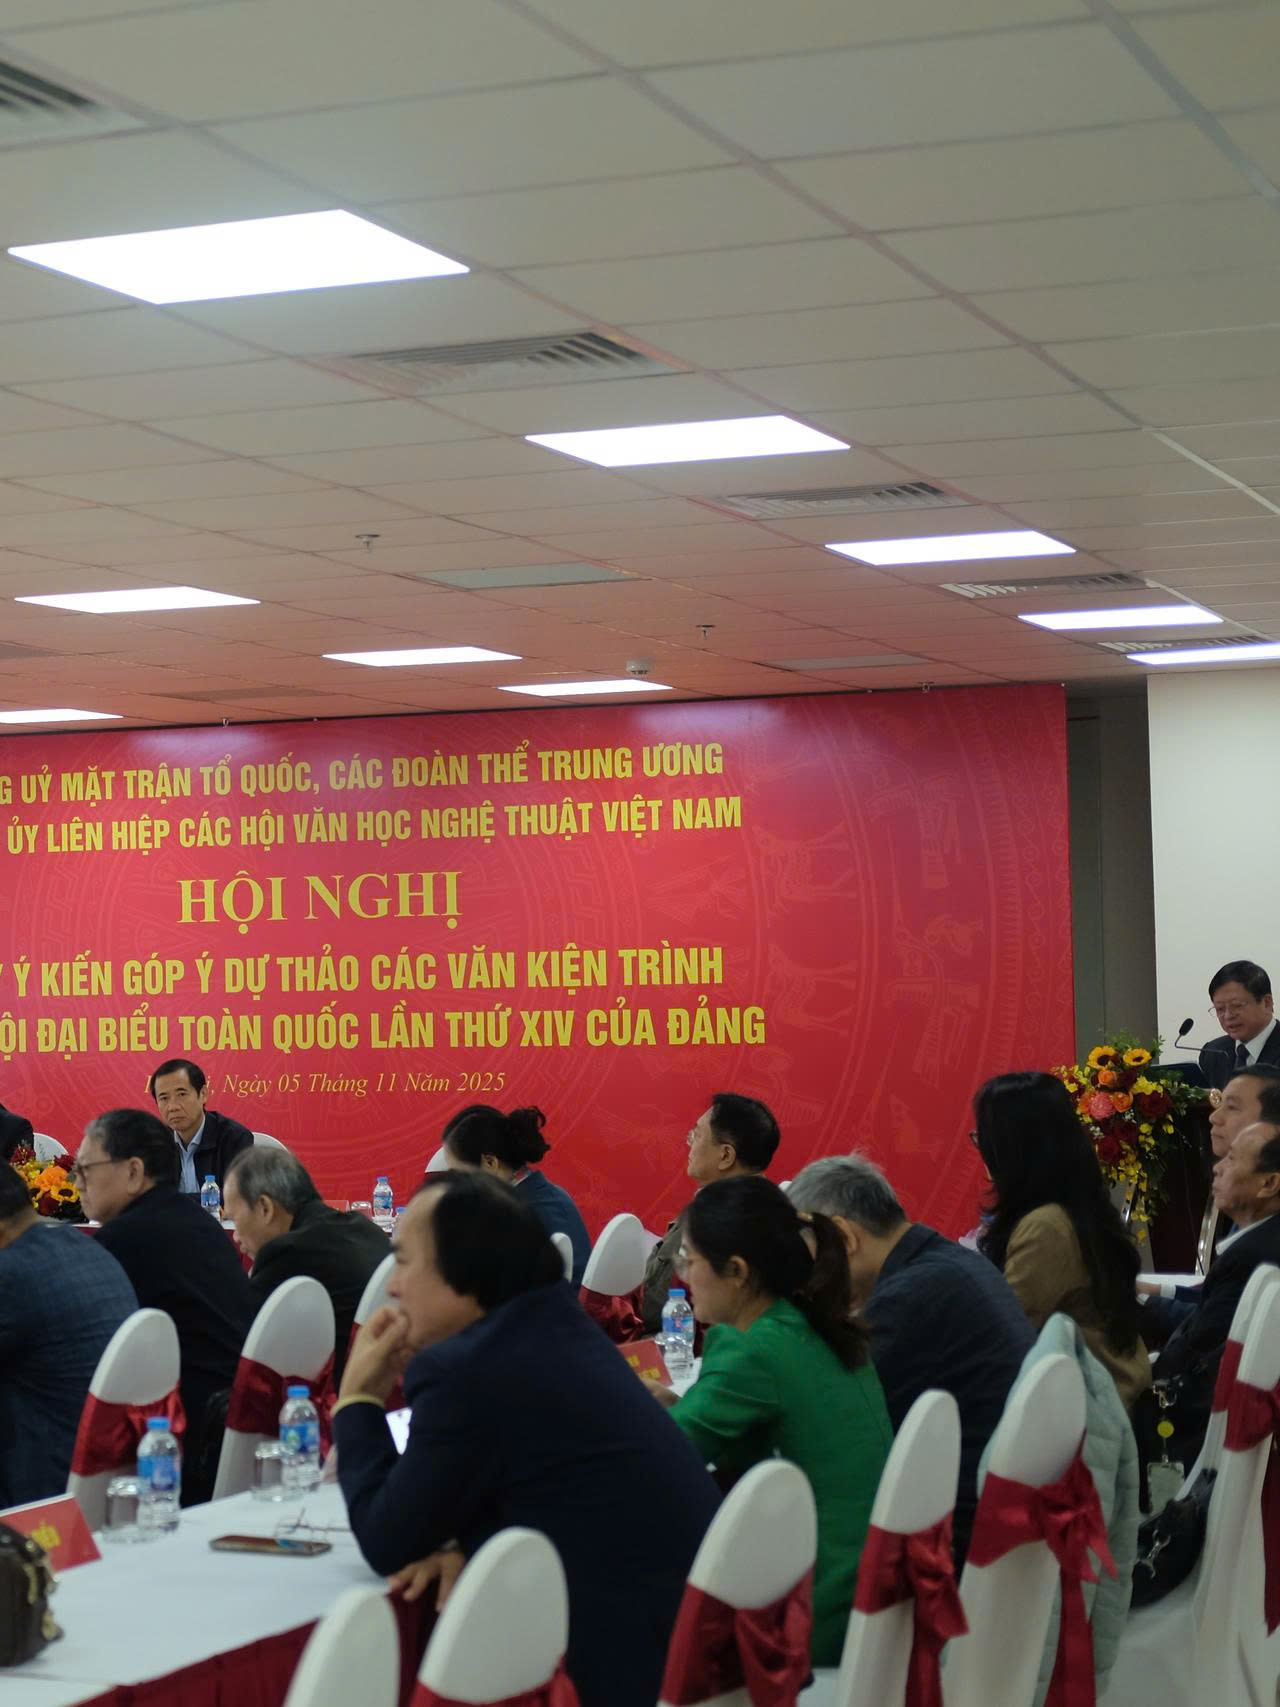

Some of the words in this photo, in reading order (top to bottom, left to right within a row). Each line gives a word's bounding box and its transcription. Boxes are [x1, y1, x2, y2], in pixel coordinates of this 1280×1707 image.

[21, 765, 52, 803] UỶ
[62, 766, 115, 807] MẶT
[124, 762, 191, 804] TRẬN
[200, 754, 231, 795] TỔ
[240, 751, 320, 797] QUỐC,
[329, 754, 382, 790] CÁC
[392, 750, 468, 787] ĐOÀN
[478, 740, 529, 784] THỂ
[538, 747, 632, 781] TRUNG
[643, 742, 722, 777] ƯƠNG
[8, 816, 38, 854] ỦY
[48, 817, 102, 852] LIÊN
[112, 814, 169, 855] HIỆP
[180, 811, 231, 847] CÁC
[241, 809, 284, 851] HỘI
[293, 807, 347, 843] VĂN
[357, 810, 411, 847] HỌC
[421, 800, 495, 843] NGHỆ
[504, 797, 593, 840] THUẬT
[602, 794, 662, 838] VIỆT
[673, 797, 741, 829] NAM
[177, 871, 287, 934] HỘI
[304, 872, 462, 929] NGHỊ
[13, 956, 30, 997] Ý
[42, 950, 112, 996] KIẾN
[123, 952, 184, 995] GÓP
[195, 951, 213, 993] Ý
[225, 954, 269, 1000] DỰ
[277, 944, 359, 992] THẢO
[372, 947, 436, 990] CÁC
[448, 945, 515, 988] VĂN
[528, 943, 607, 995] KIỆN
[618, 941, 722, 985] TRÌNH
[37, 1018, 87, 1060] ĐẠI
[99, 1002, 168, 1051] BIỂU
[179, 1008, 261, 1050] TOÀN
[273, 1001, 358, 1053] QUỐC
[371, 1000, 433, 1048] LẦN
[445, 1003, 512, 1047] THỨ
[520, 1010, 574, 1046] XIV
[587, 997, 656, 1046] CỦA
[667, 995, 765, 1044] ĐẢNG
[222, 1073, 272, 1098] Ngày
[279, 1074, 300, 1092] 05
[309, 1073, 368, 1096] Tháng
[376, 1073, 396, 1091] 11
[405, 1073, 449, 1091] Năm
[457, 1072, 505, 1091] 2025
